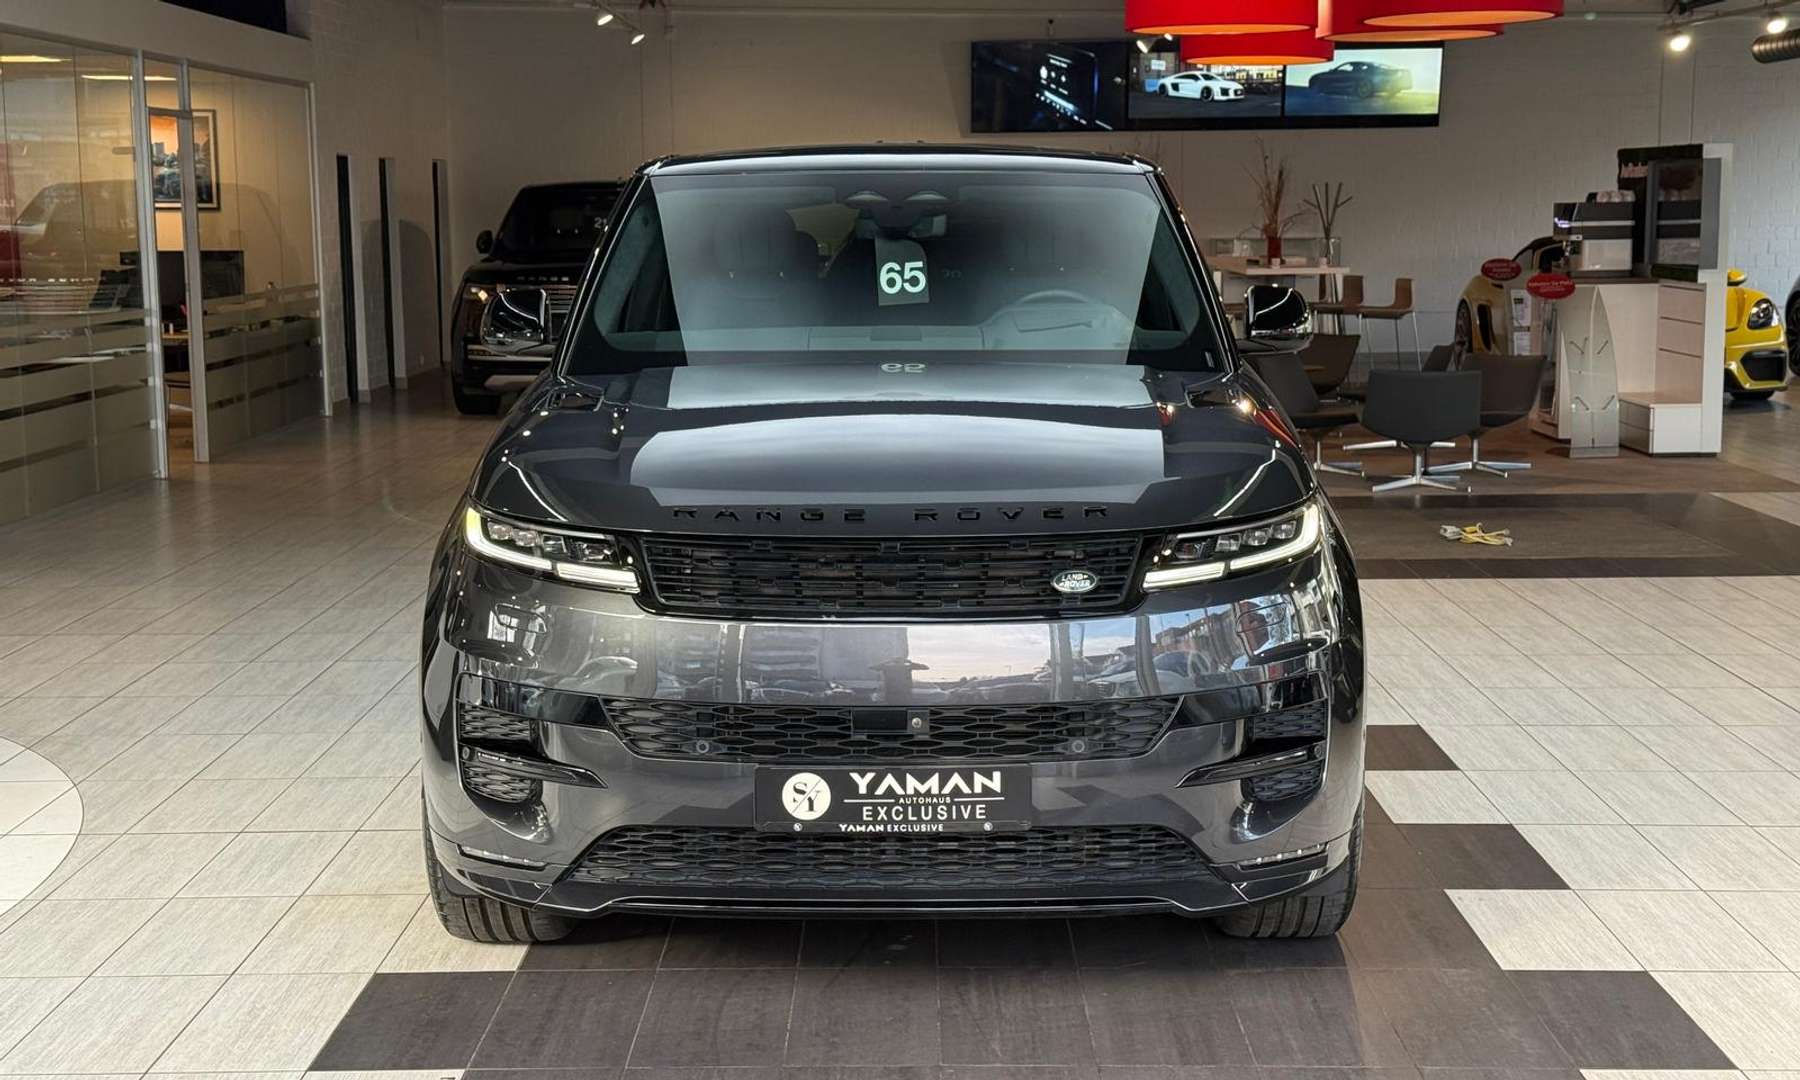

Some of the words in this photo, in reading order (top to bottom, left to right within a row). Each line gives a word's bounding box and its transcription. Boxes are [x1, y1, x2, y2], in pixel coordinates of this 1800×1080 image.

[880, 261, 926, 294] 65
[672, 507, 866, 521] RANGE
[913, 505, 1108, 521] ROVER
[1061, 573, 1084, 582] LAND
[1064, 579, 1091, 589] ROVER
[849, 770, 1001, 796] YAMAN
[898, 796, 951, 805] AUTOHAUS
[863, 804, 987, 821] EXCLUSIVE
[839, 823, 885, 832] YAMAN
[887, 823, 944, 832] EXCLUSIVE
